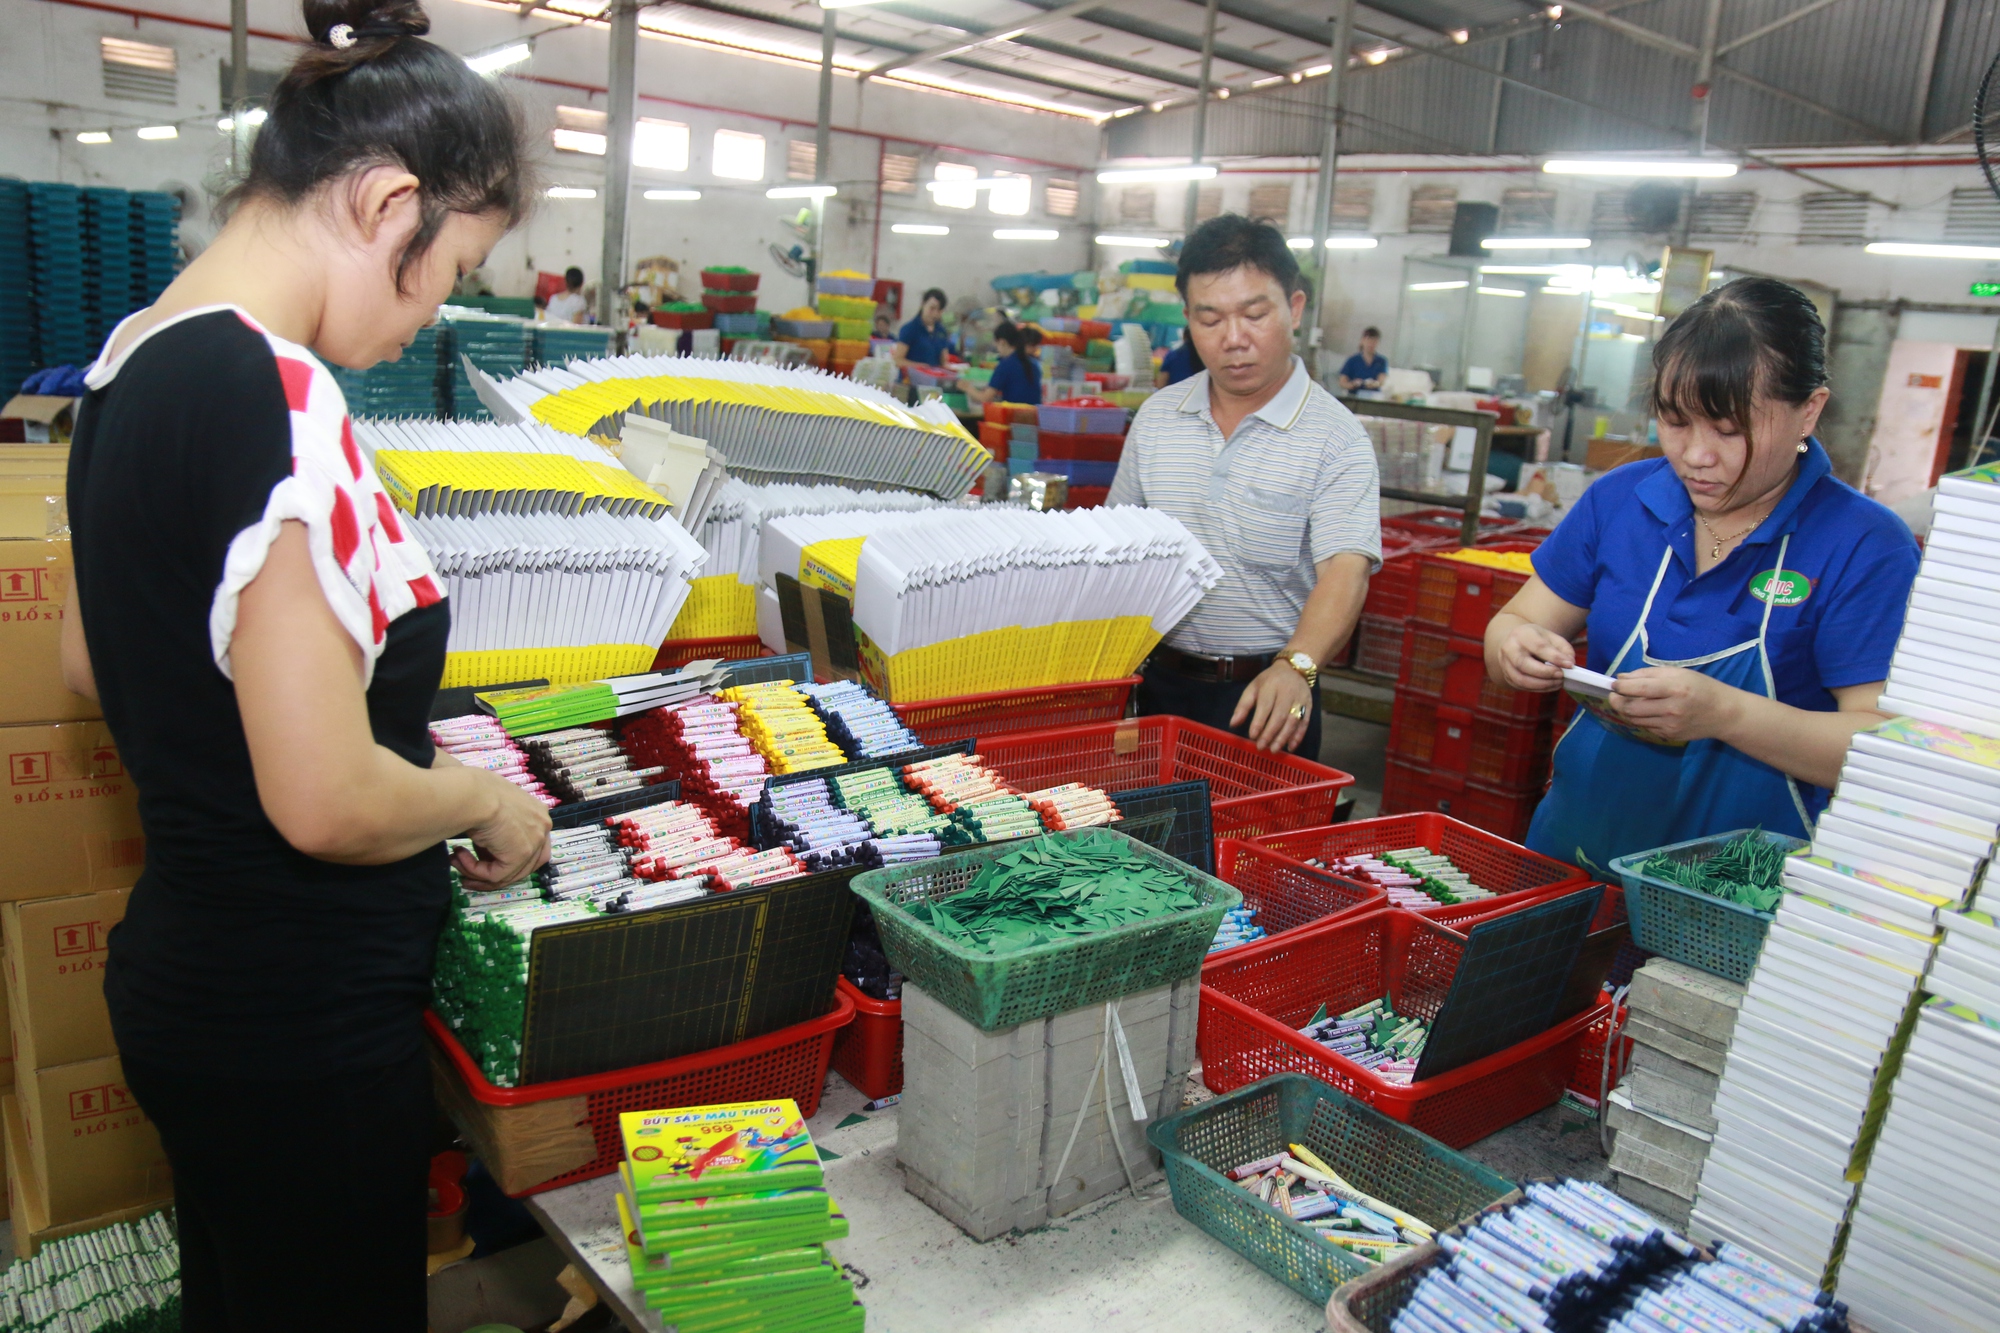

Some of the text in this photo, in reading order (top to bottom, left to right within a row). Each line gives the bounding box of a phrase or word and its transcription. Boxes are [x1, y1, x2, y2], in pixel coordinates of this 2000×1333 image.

[2, 611, 11, 622] 9
[16, 605, 38, 621] LỐ
[14, 793, 23, 804] 9
[28, 787, 50, 802] LỐ
[69, 788, 84, 799] 12
[89, 783, 122, 798] HỘP
[58, 964, 67, 974] 9
[642, 1115, 671, 1126] BÚT
[674, 1113, 701, 1124] SÁP
[742, 1105, 781, 1117] THƠM
[73, 1127, 82, 1138] 9
[700, 1123, 734, 1135] 999
